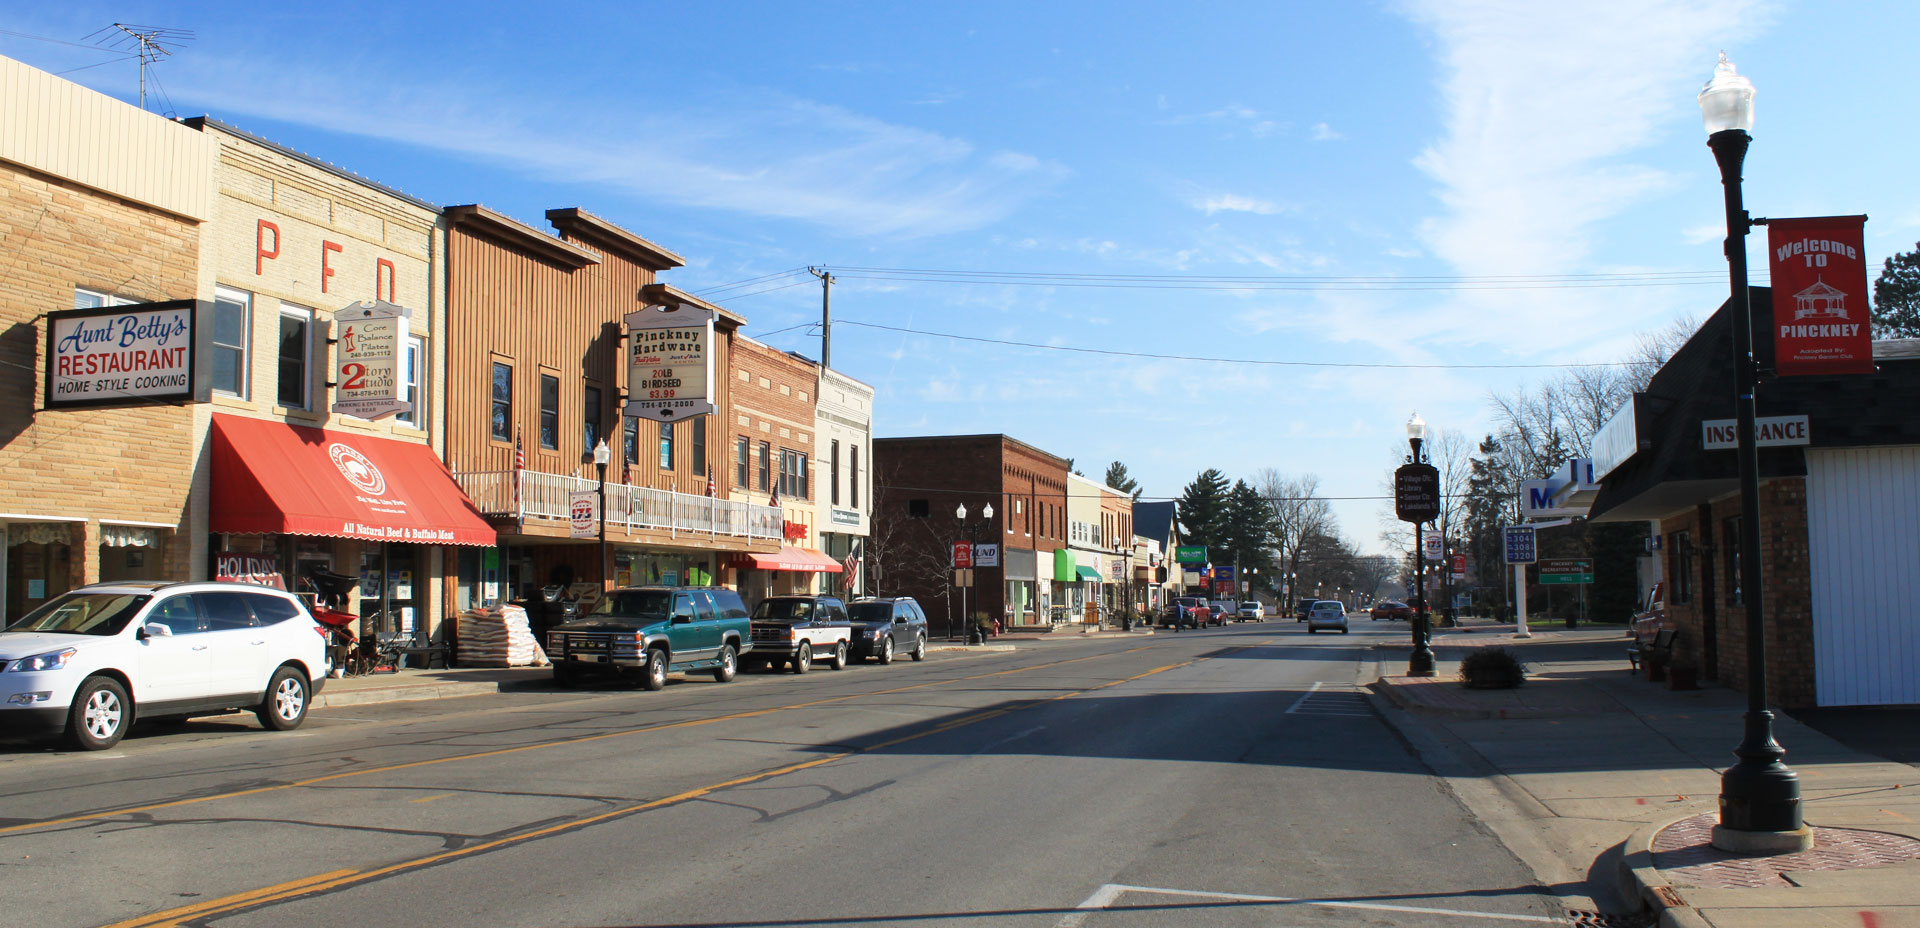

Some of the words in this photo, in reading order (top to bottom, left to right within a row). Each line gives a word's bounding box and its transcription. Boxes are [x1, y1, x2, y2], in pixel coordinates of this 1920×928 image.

[1776, 238, 1856, 262] Welcome
[1803, 254, 1828, 268] TO
[58, 319, 116, 353] Aunt
[118, 315, 187, 348] Betty's
[364, 324, 387, 332] Core
[1780, 324, 1860, 338] PINCKNEY
[358, 334, 393, 342] Balance
[636, 330, 699, 343] Pinckney
[361, 343, 389, 351] Pilates
[634, 342, 701, 355] Hardware
[58, 347, 186, 376] RESTAURANT
[652, 369, 672, 378] 20LB
[58, 381, 91, 394] HOME
[96, 378, 130, 392] STYLE
[135, 374, 186, 389] COOKING
[642, 379, 681, 389] BIRDSEED
[650, 390, 675, 399] $3.99
[1706, 422, 1805, 443] INSANCE
[572, 508, 592, 519] 175
[343, 522, 354, 533] All
[357, 524, 384, 537] Natural
[387, 527, 403, 538] Beef
[404, 528, 410, 538] &
[412, 529, 437, 539] Buffalo
[438, 530, 454, 540] Meat
[218, 557, 278, 578] HOLIDAY
